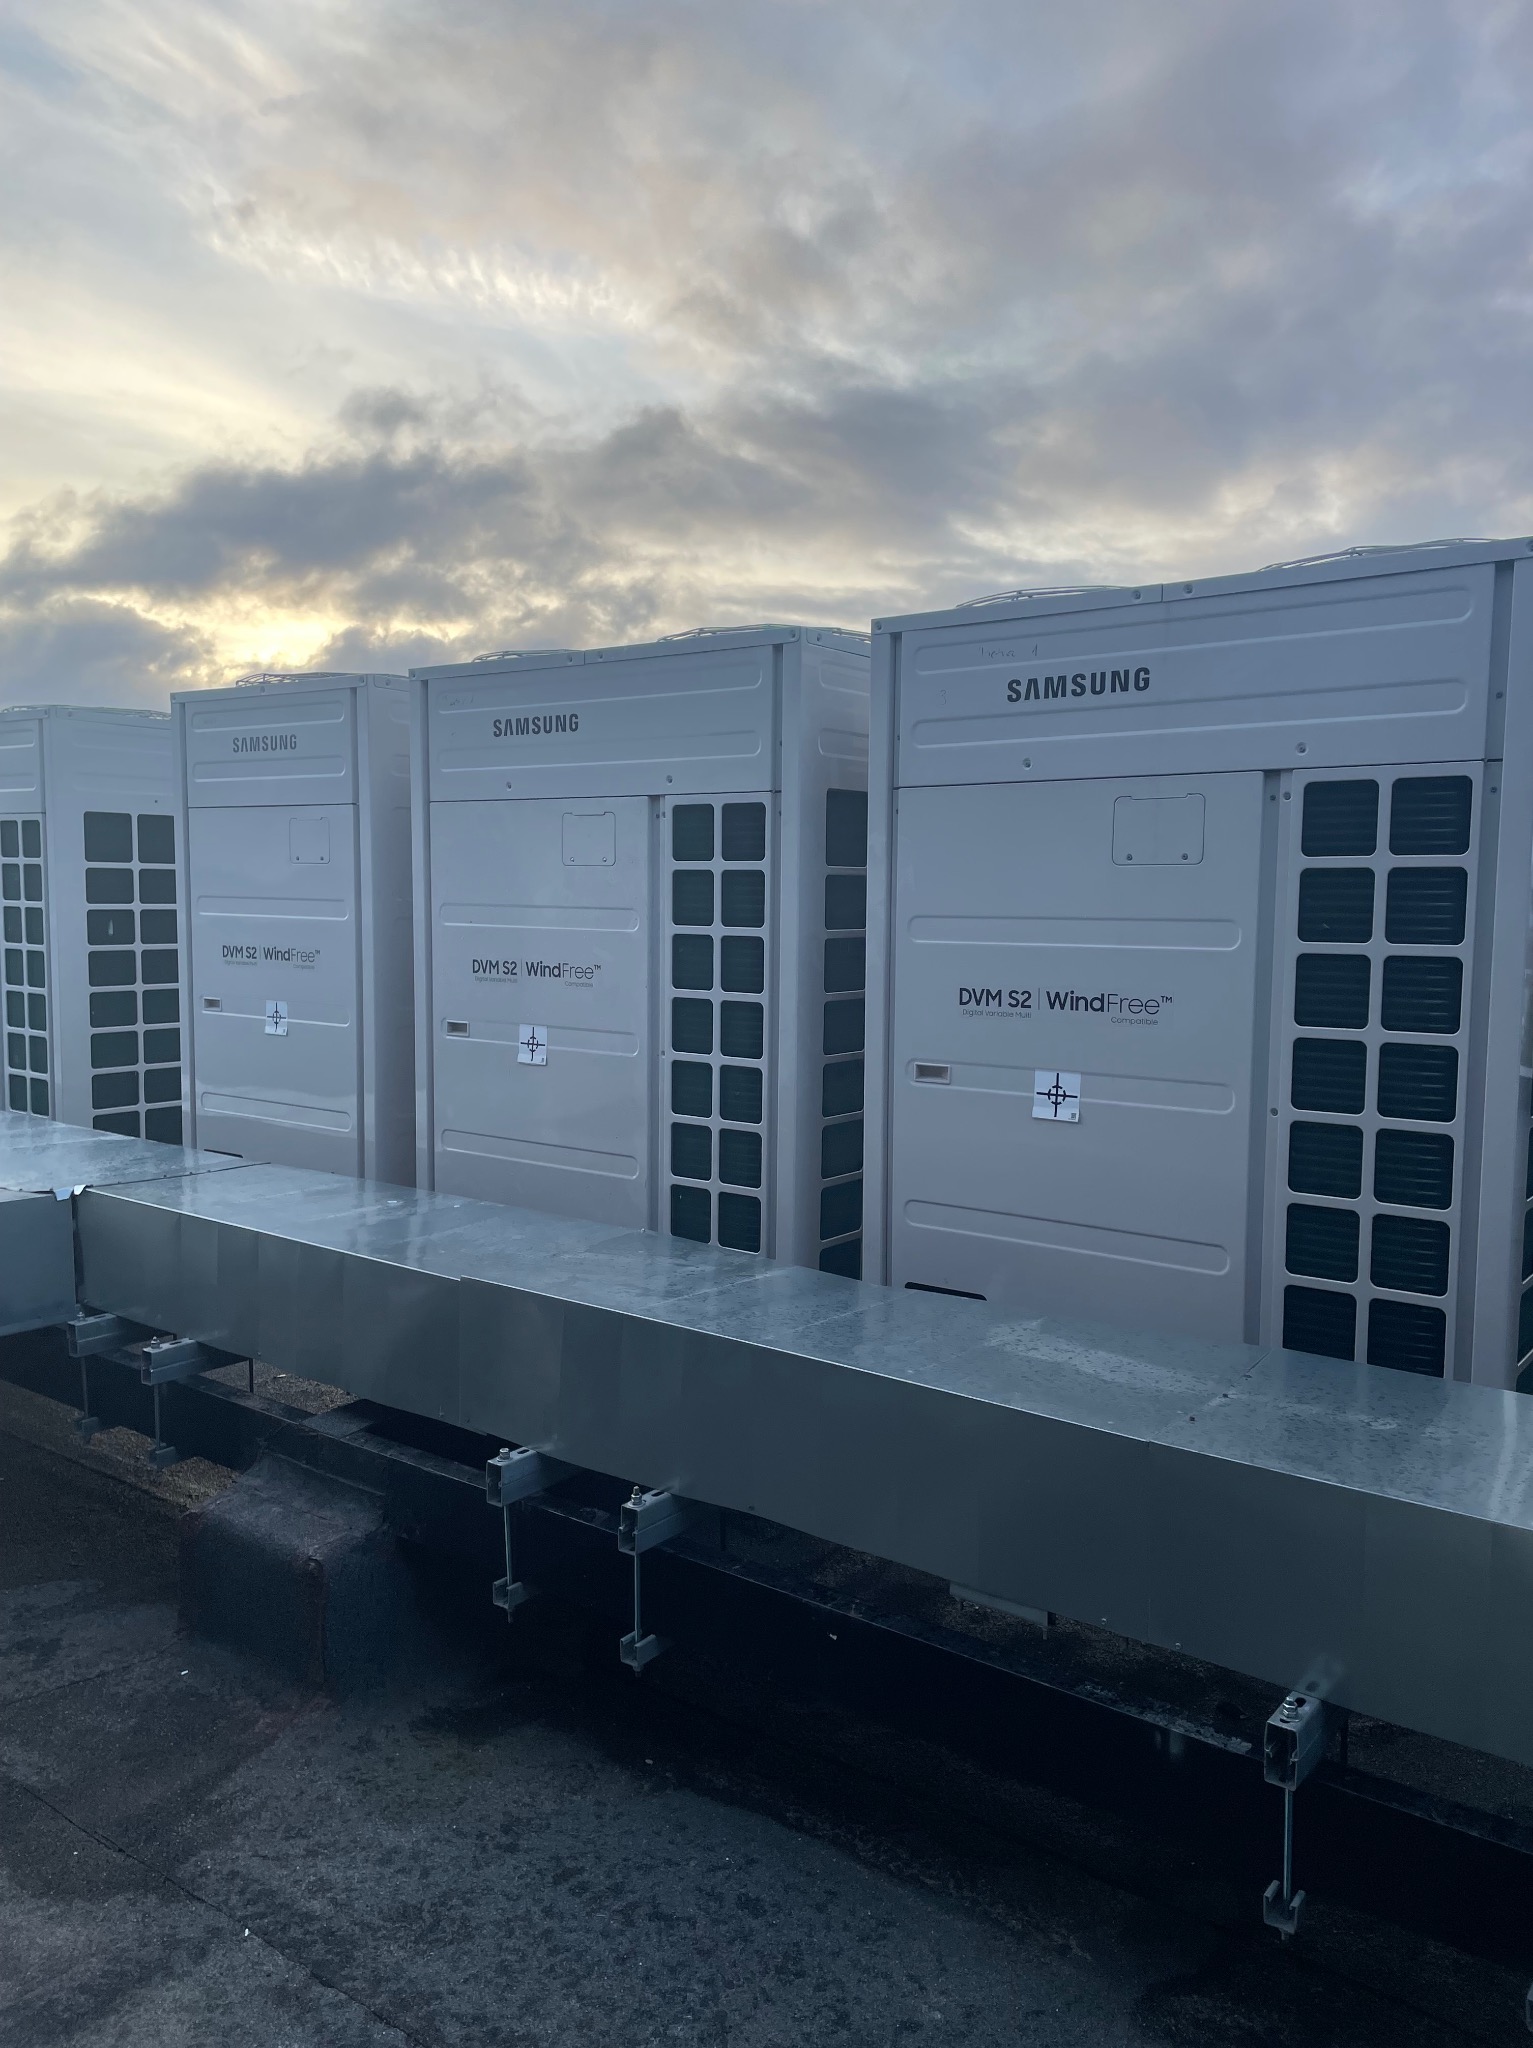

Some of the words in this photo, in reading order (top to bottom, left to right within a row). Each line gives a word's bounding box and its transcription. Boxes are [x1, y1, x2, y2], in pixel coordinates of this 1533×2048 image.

[1007, 667, 1150, 702] SAMSUNG
[493, 713, 580, 738] SAMSUNG
[232, 734, 297, 753] SAMSUNG
[222, 945, 243, 959] DVM
[246, 947, 257, 959] S2
[472, 959, 499, 975] DVM
[503, 961, 517, 976] S2
[959, 987, 1002, 1007] DVM
[1008, 989, 1031, 1009] S2
[962, 1008, 983, 1018] Digital
[985, 1009, 1014, 1018] Variable
[1015, 1011, 1031, 1019] Multi
[1111, 1016, 1158, 1026] Compatible
